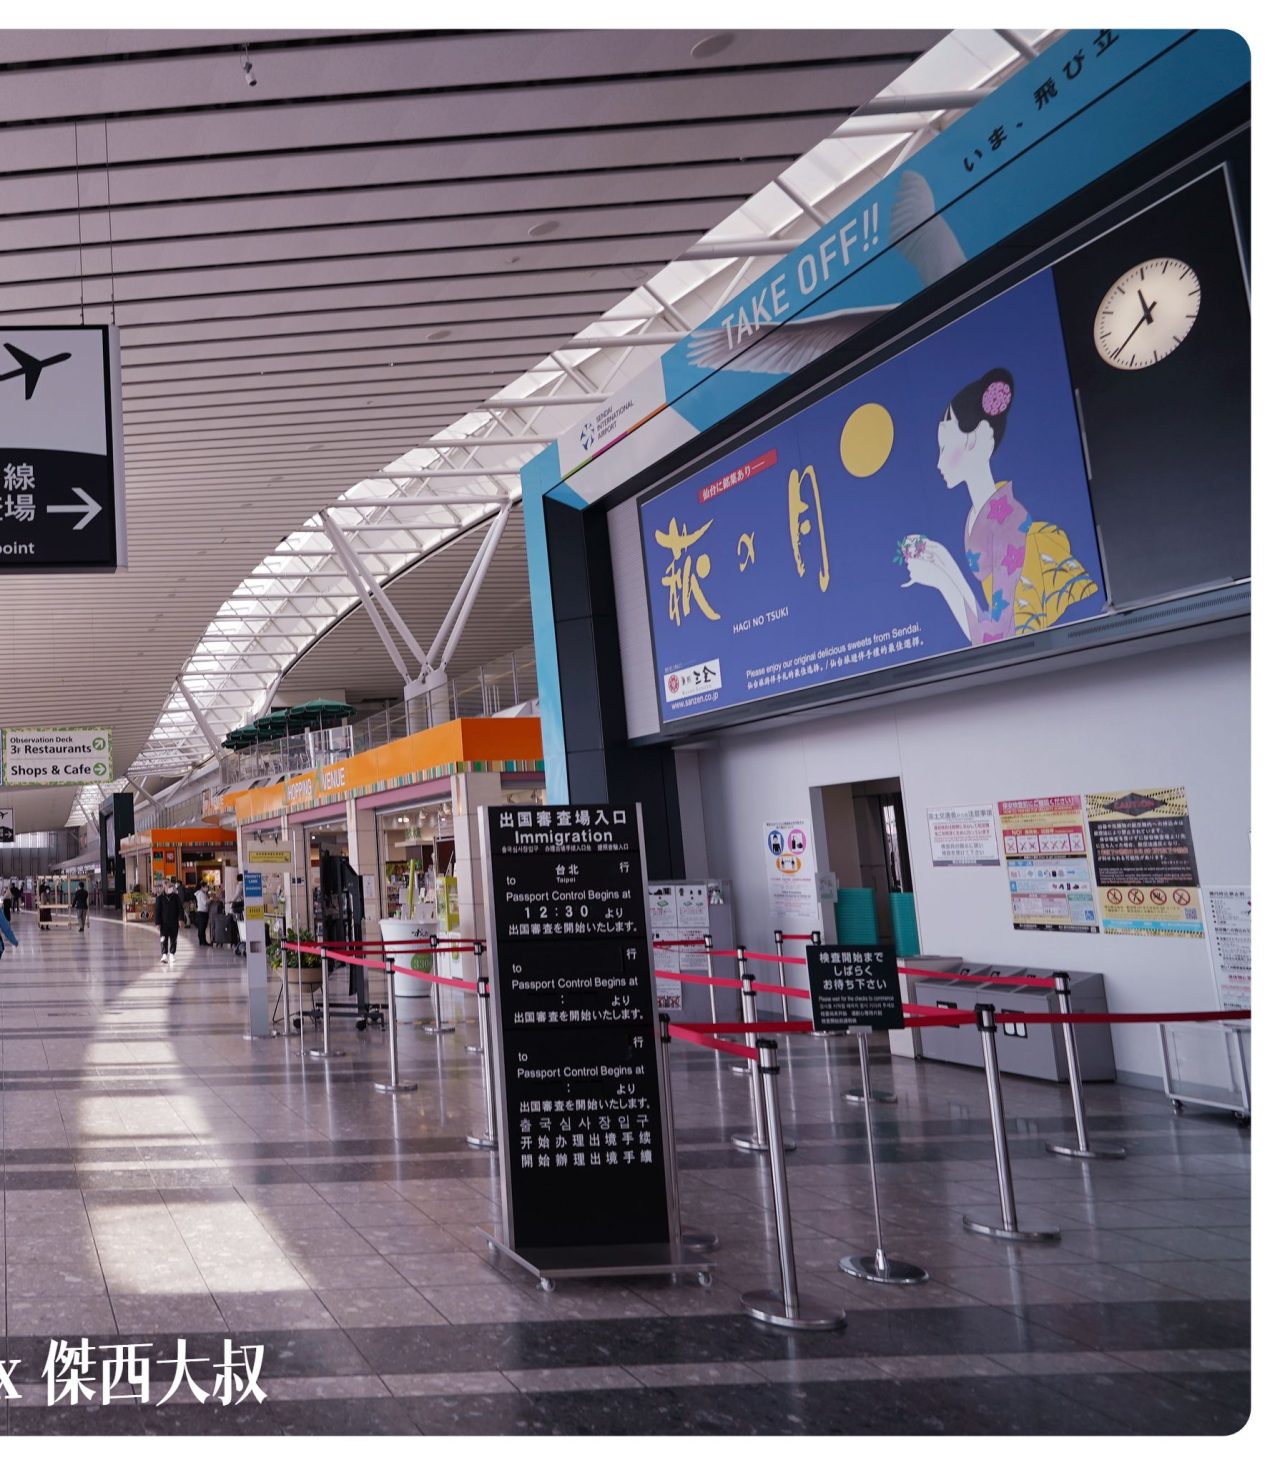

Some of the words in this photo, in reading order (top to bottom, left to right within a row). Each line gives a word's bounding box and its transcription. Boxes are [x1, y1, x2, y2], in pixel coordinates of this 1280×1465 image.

[721, 273, 790, 350] TAKE
[797, 202, 879, 295] OFF!!
[733, 620, 751, 635] HAGI
[752, 615, 765, 627] NO
[766, 606, 789, 623] TSUKI
[746, 666, 765, 679] Please
[766, 662, 782, 675] enjoy
[783, 659, 793, 668] our
[793, 651, 816, 666] original
[817, 644, 846, 659] delicious
[847, 636, 872, 651] sweets
[873, 631, 891, 643] from
[892, 622, 922, 639] Sendai.
[671, 691, 719, 710] www.sanzen.co.jp
[10, 736, 54, 744] Observation
[24, 744, 92, 754] Restaurants
[11, 765, 48, 778] Shops
[51, 765, 60, 775] &
[64, 764, 91, 775] Cafe
[500, 810, 627, 828] 出国審査場入口
[515, 830, 613, 845] Immigration
[555, 864, 579, 875] 台北
[620, 862, 629, 873] 行
[506, 876, 516, 885] to
[506, 891, 549, 903] Passport
[551, 890, 585, 900] Control
[588, 889, 619, 901] Begins
[622, 890, 631, 898] at
[605, 908, 623, 918] より
[508, 921, 637, 936] 出国審査を開始いたします。
[626, 948, 637, 960] 行
[819, 952, 884, 964] 検査開始まで
[512, 963, 522, 973] to
[833, 965, 873, 976] しばらく
[512, 978, 555, 991] Passport
[558, 977, 593, 988] Control
[594, 976, 627, 989] Begins
[629, 976, 639, 986] at
[823, 979, 887, 990] お待ち下さい
[612, 995, 630, 1006] より
[514, 1008, 644, 1024] 出国審査を開始いたします。
[633, 1036, 644, 1048] 行
[518, 1052, 528, 1062] to
[517, 1068, 561, 1080] Passport
[563, 1066, 599, 1077] Control
[600, 1065, 633, 1078] Begins
[635, 1065, 645, 1075] at
[617, 1083, 635, 1095] より
[520, 1097, 650, 1113] 出国審査を開始いたします。
